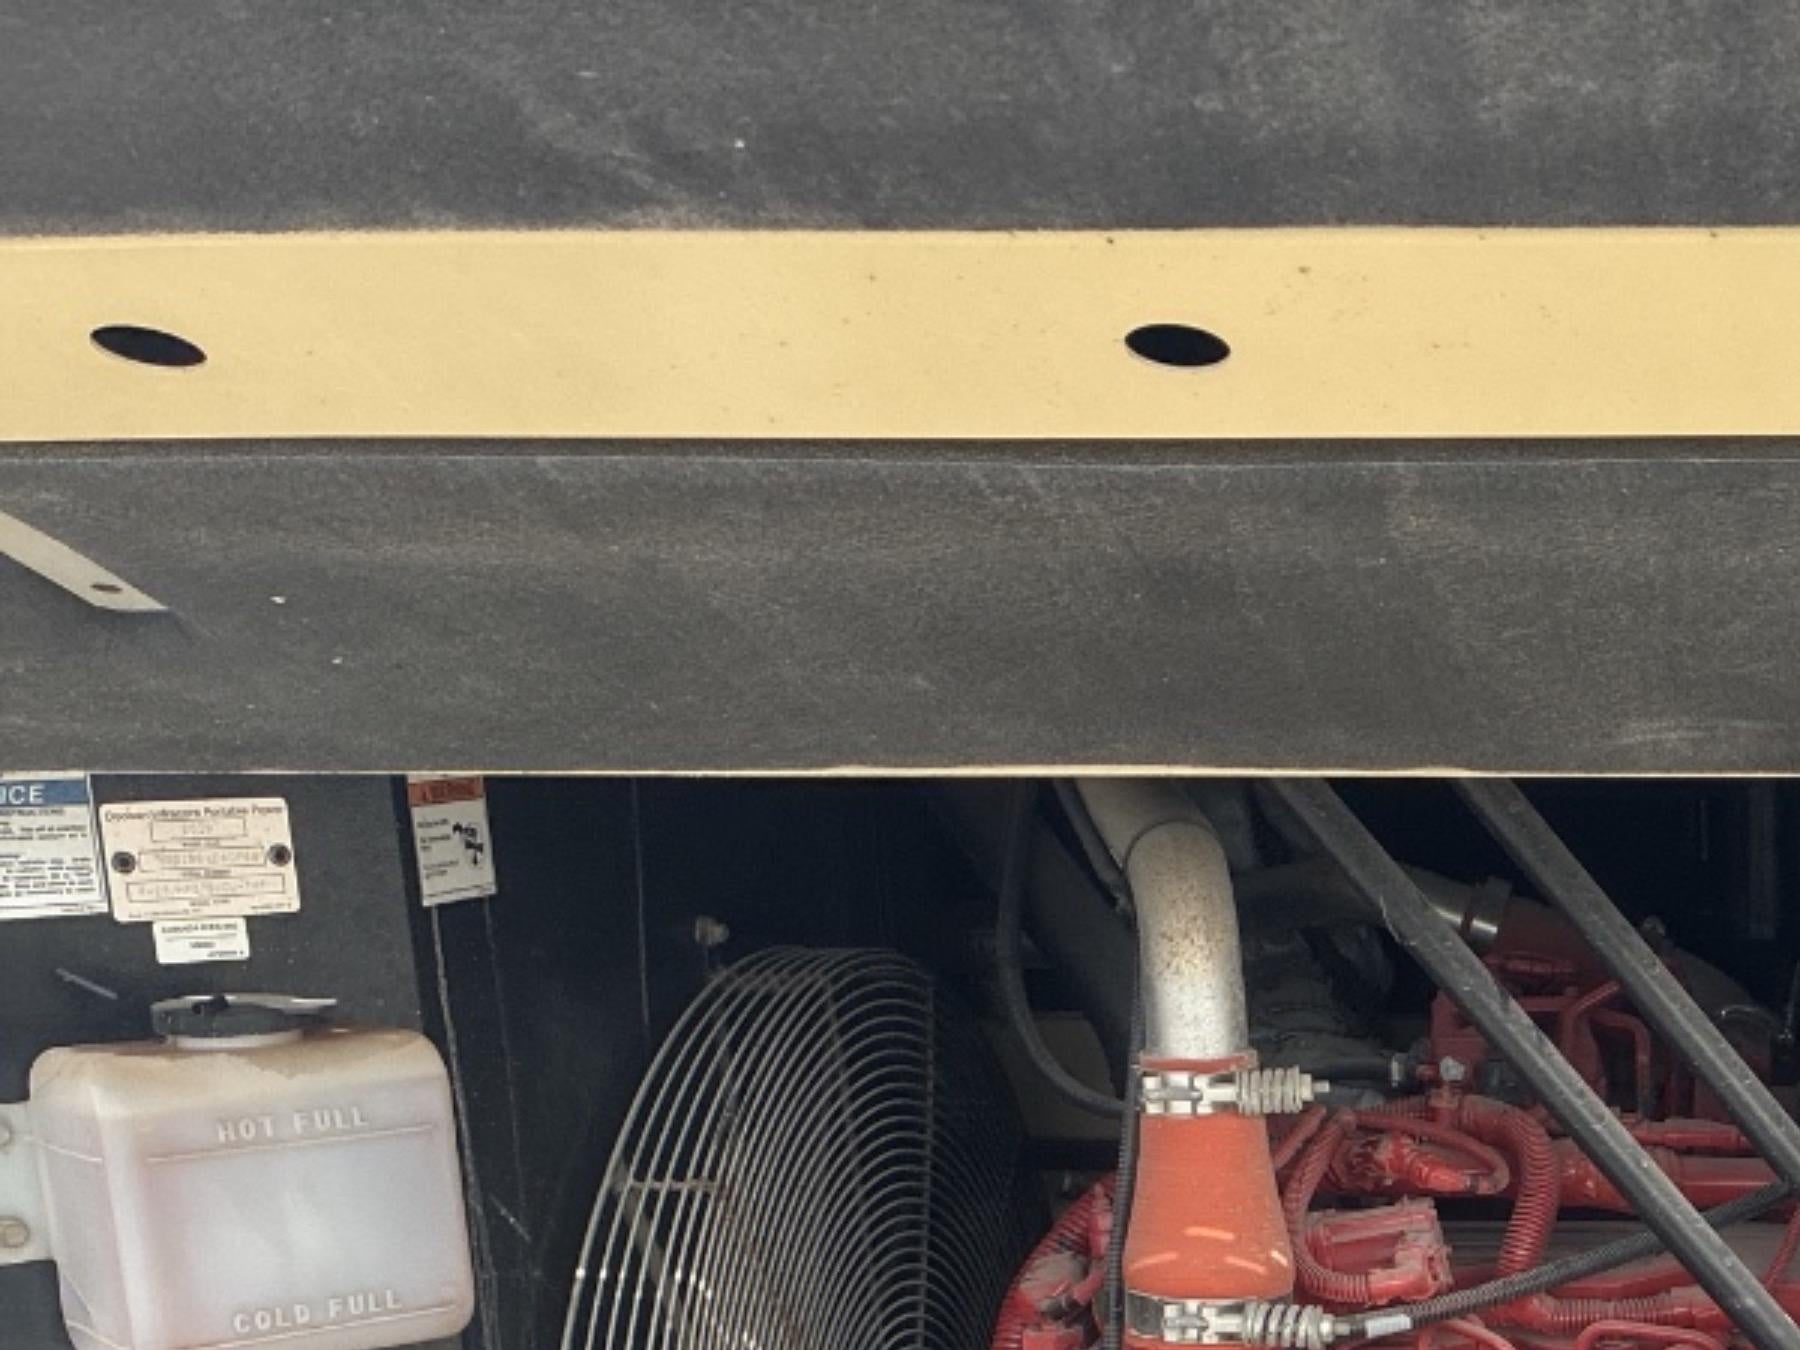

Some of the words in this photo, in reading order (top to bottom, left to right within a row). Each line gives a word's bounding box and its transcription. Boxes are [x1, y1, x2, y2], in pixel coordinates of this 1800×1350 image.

[216, 1115, 274, 1144] HOT
[292, 1107, 369, 1135] FULL
[233, 1303, 312, 1333] COLD
[327, 1289, 403, 1319] FULL
